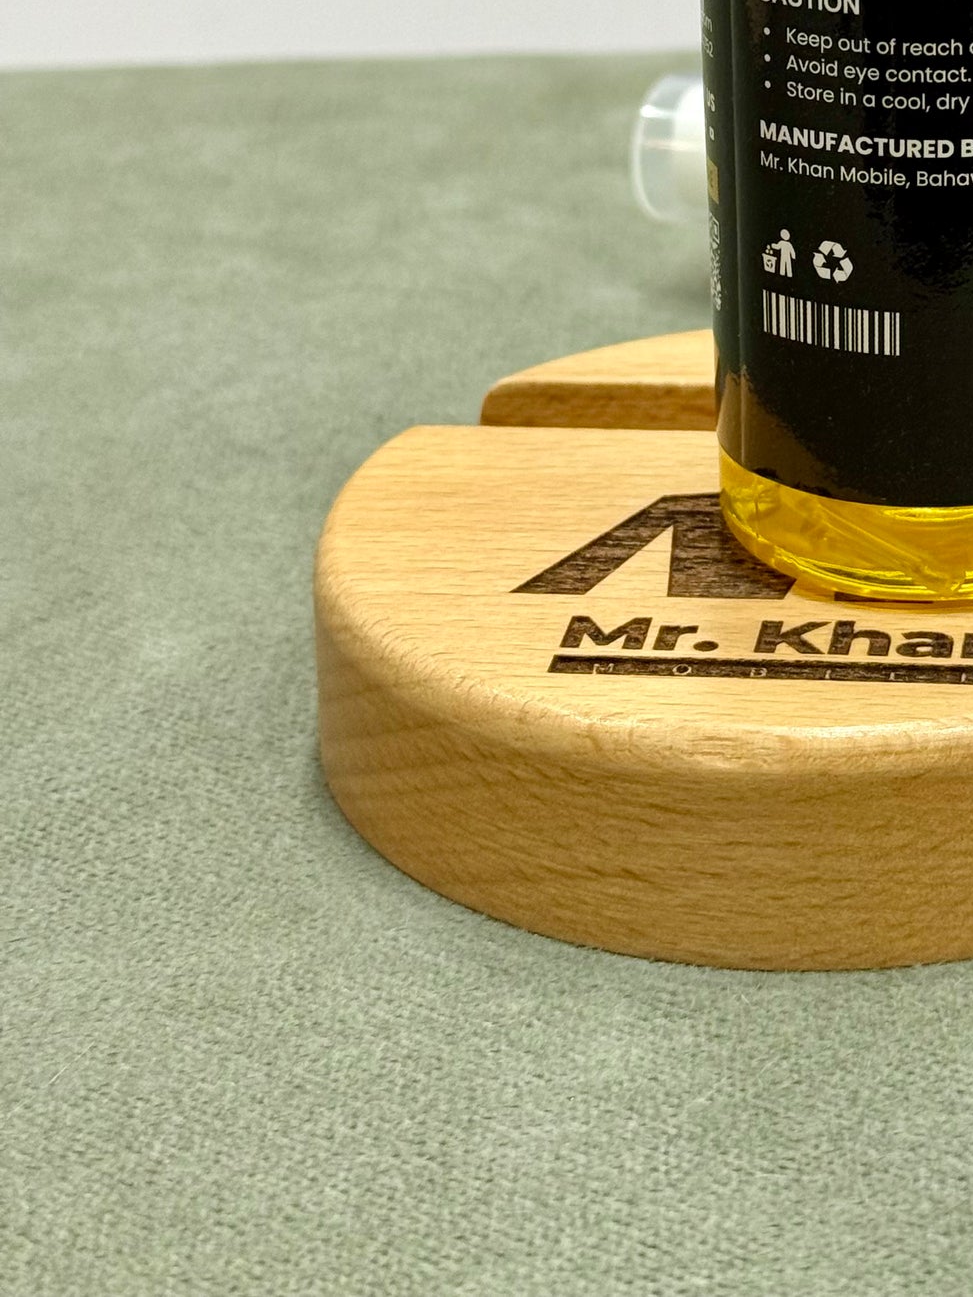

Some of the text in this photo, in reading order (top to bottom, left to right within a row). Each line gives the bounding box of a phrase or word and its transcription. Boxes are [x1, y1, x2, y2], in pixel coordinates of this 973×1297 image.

[786, 26, 833, 54] Keep
[837, 37, 871, 54] out
[875, 37, 897, 56] of
[902, 38, 963, 57] reach
[786, 54, 972, 85] Avoid eye contact.
[786, 81, 835, 103] Store
[839, 87, 857, 106] in
[862, 94, 876, 108] a
[881, 92, 931, 113] cool,
[936, 92, 971, 115] dry
[759, 119, 955, 159] MANUFACTURED
[760, 150, 784, 171] Mr.
[787, 156, 835, 180] Khan
[840, 165, 911, 190] Mobile,
[559, 614, 719, 653] Mr.
